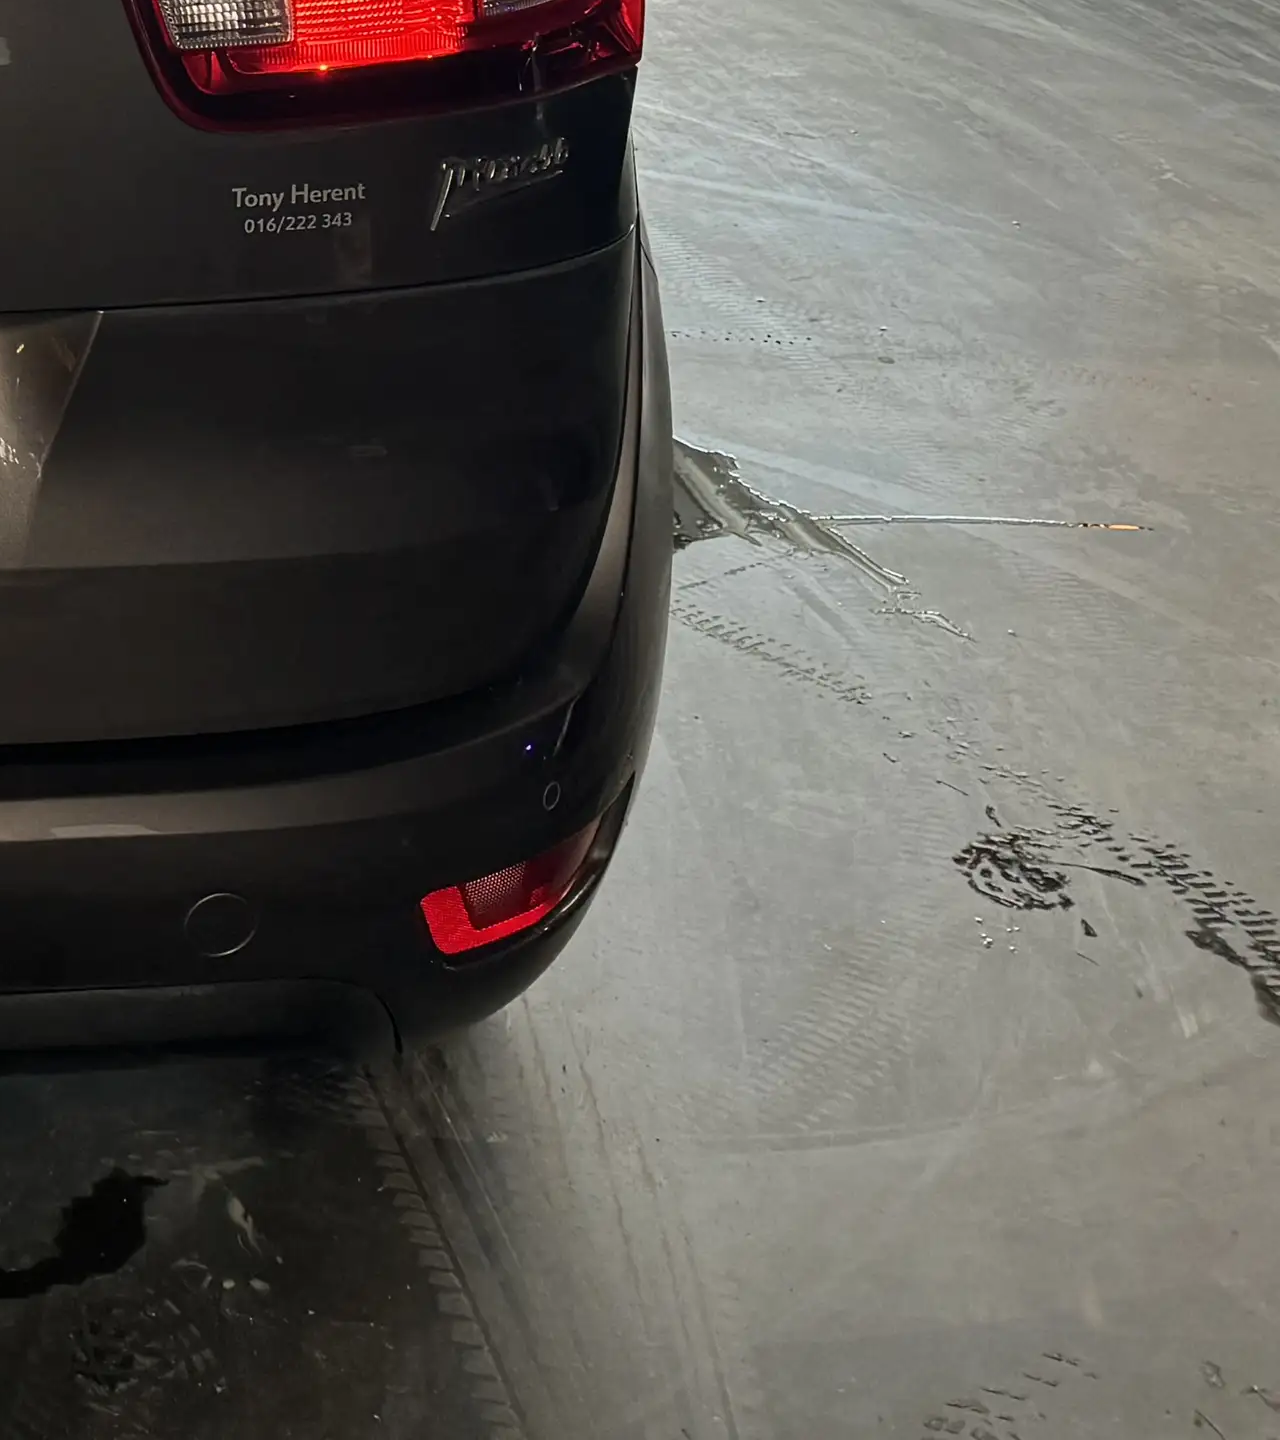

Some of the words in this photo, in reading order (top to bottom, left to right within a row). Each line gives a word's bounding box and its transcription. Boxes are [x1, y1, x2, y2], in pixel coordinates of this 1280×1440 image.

[231, 186, 285, 213] Tony
[290, 182, 367, 205] Herent
[243, 214, 317, 234] 016/222
[321, 211, 353, 229] 343
